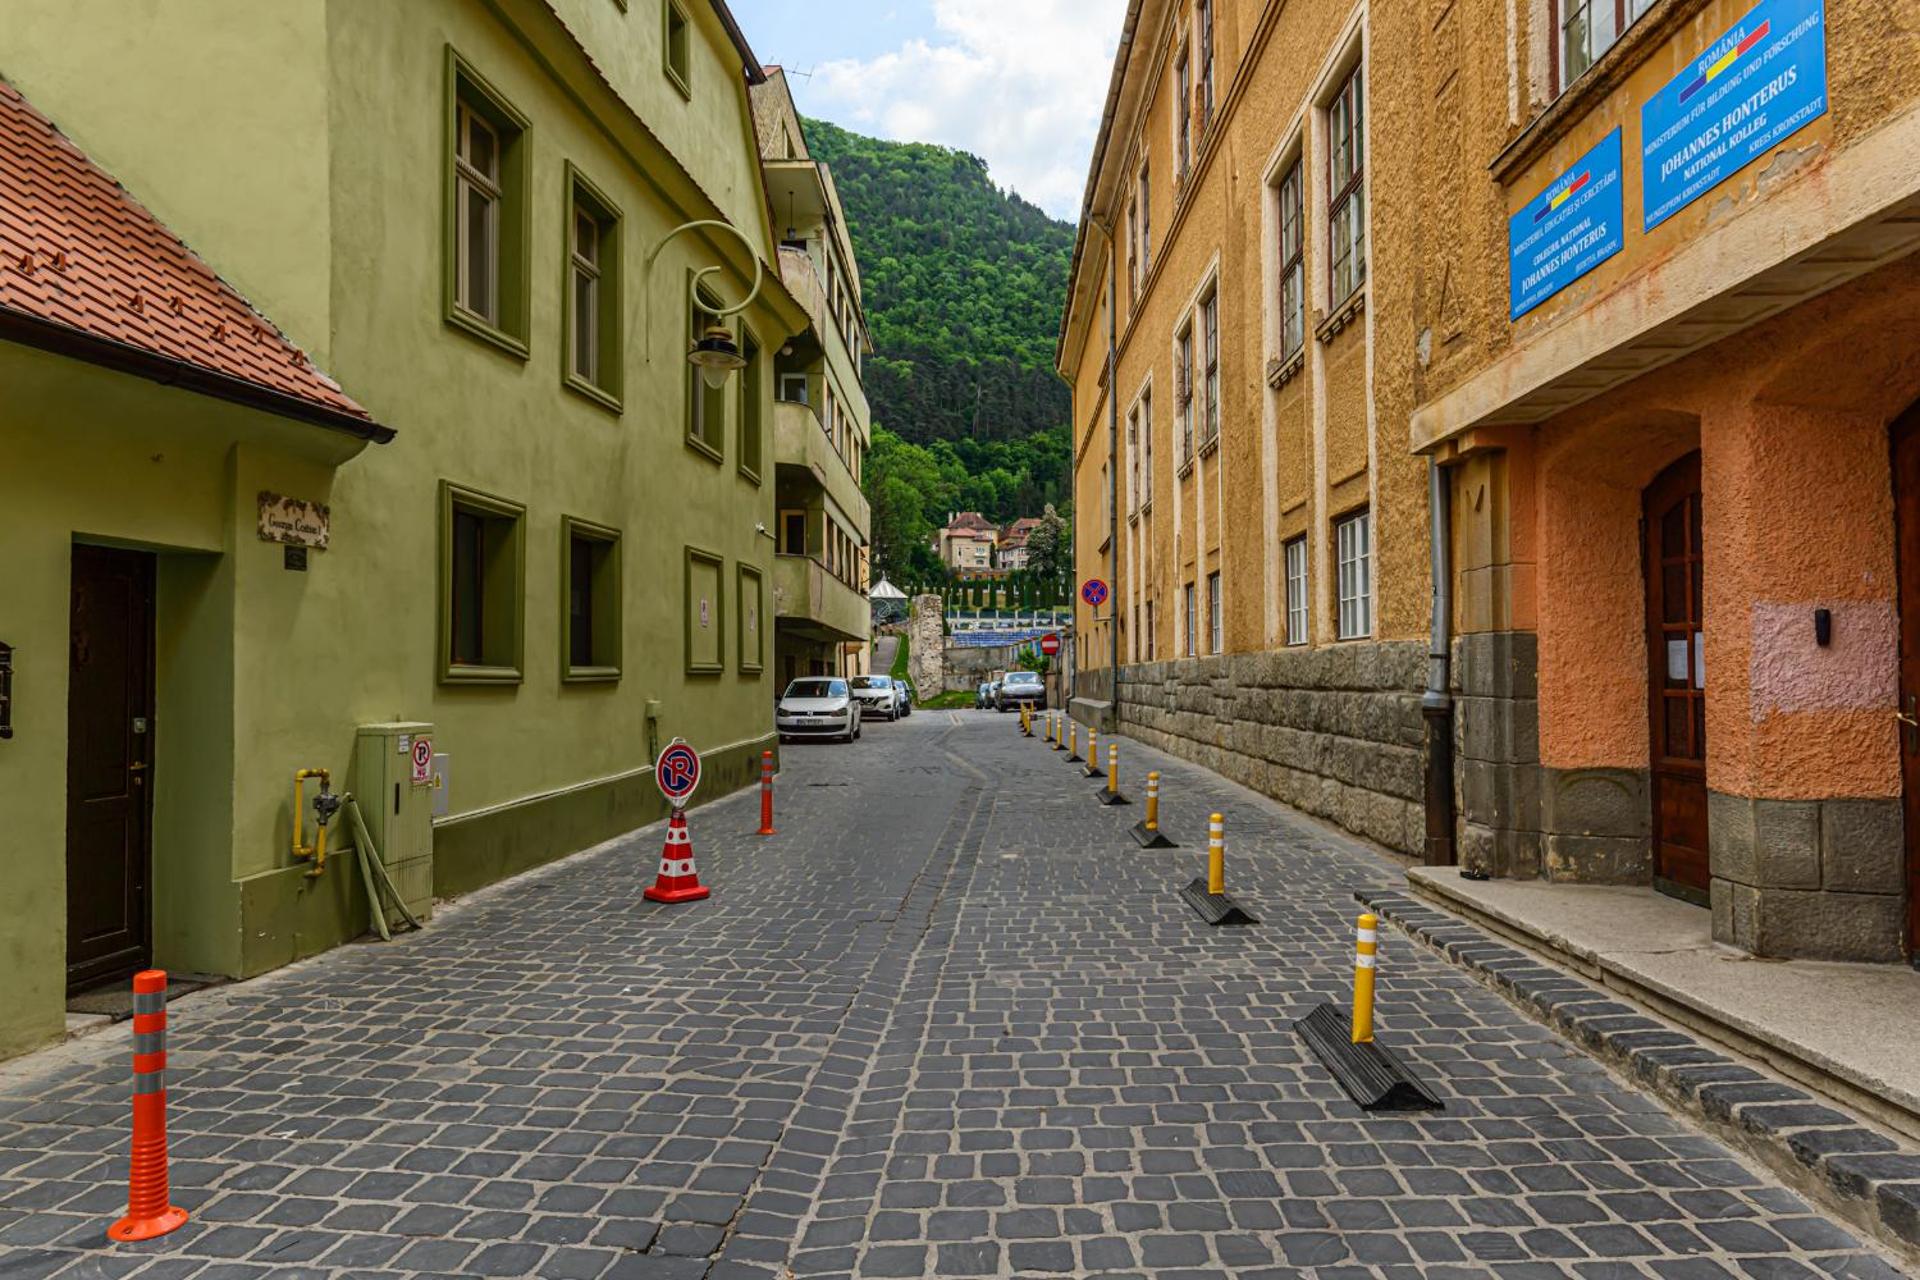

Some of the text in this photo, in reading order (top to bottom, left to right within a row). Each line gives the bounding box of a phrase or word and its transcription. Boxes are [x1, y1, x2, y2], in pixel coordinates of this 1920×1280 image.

[1644, 10, 1820, 158] MINISTERIUM FÜR BILDUNG UND FORSCHUNG
[1698, 26, 1746, 75] ROMÂNIA
[1661, 64, 1798, 183] JOHANNES HONTERUS
[1683, 112, 1768, 182] NATIONAL KOLLEG
[1748, 95, 1823, 154] KREIS KRONSTADT
[1682, 165, 1722, 199] KRONSTADT
[1522, 221, 1607, 295] JOHANNES HONTERUS
